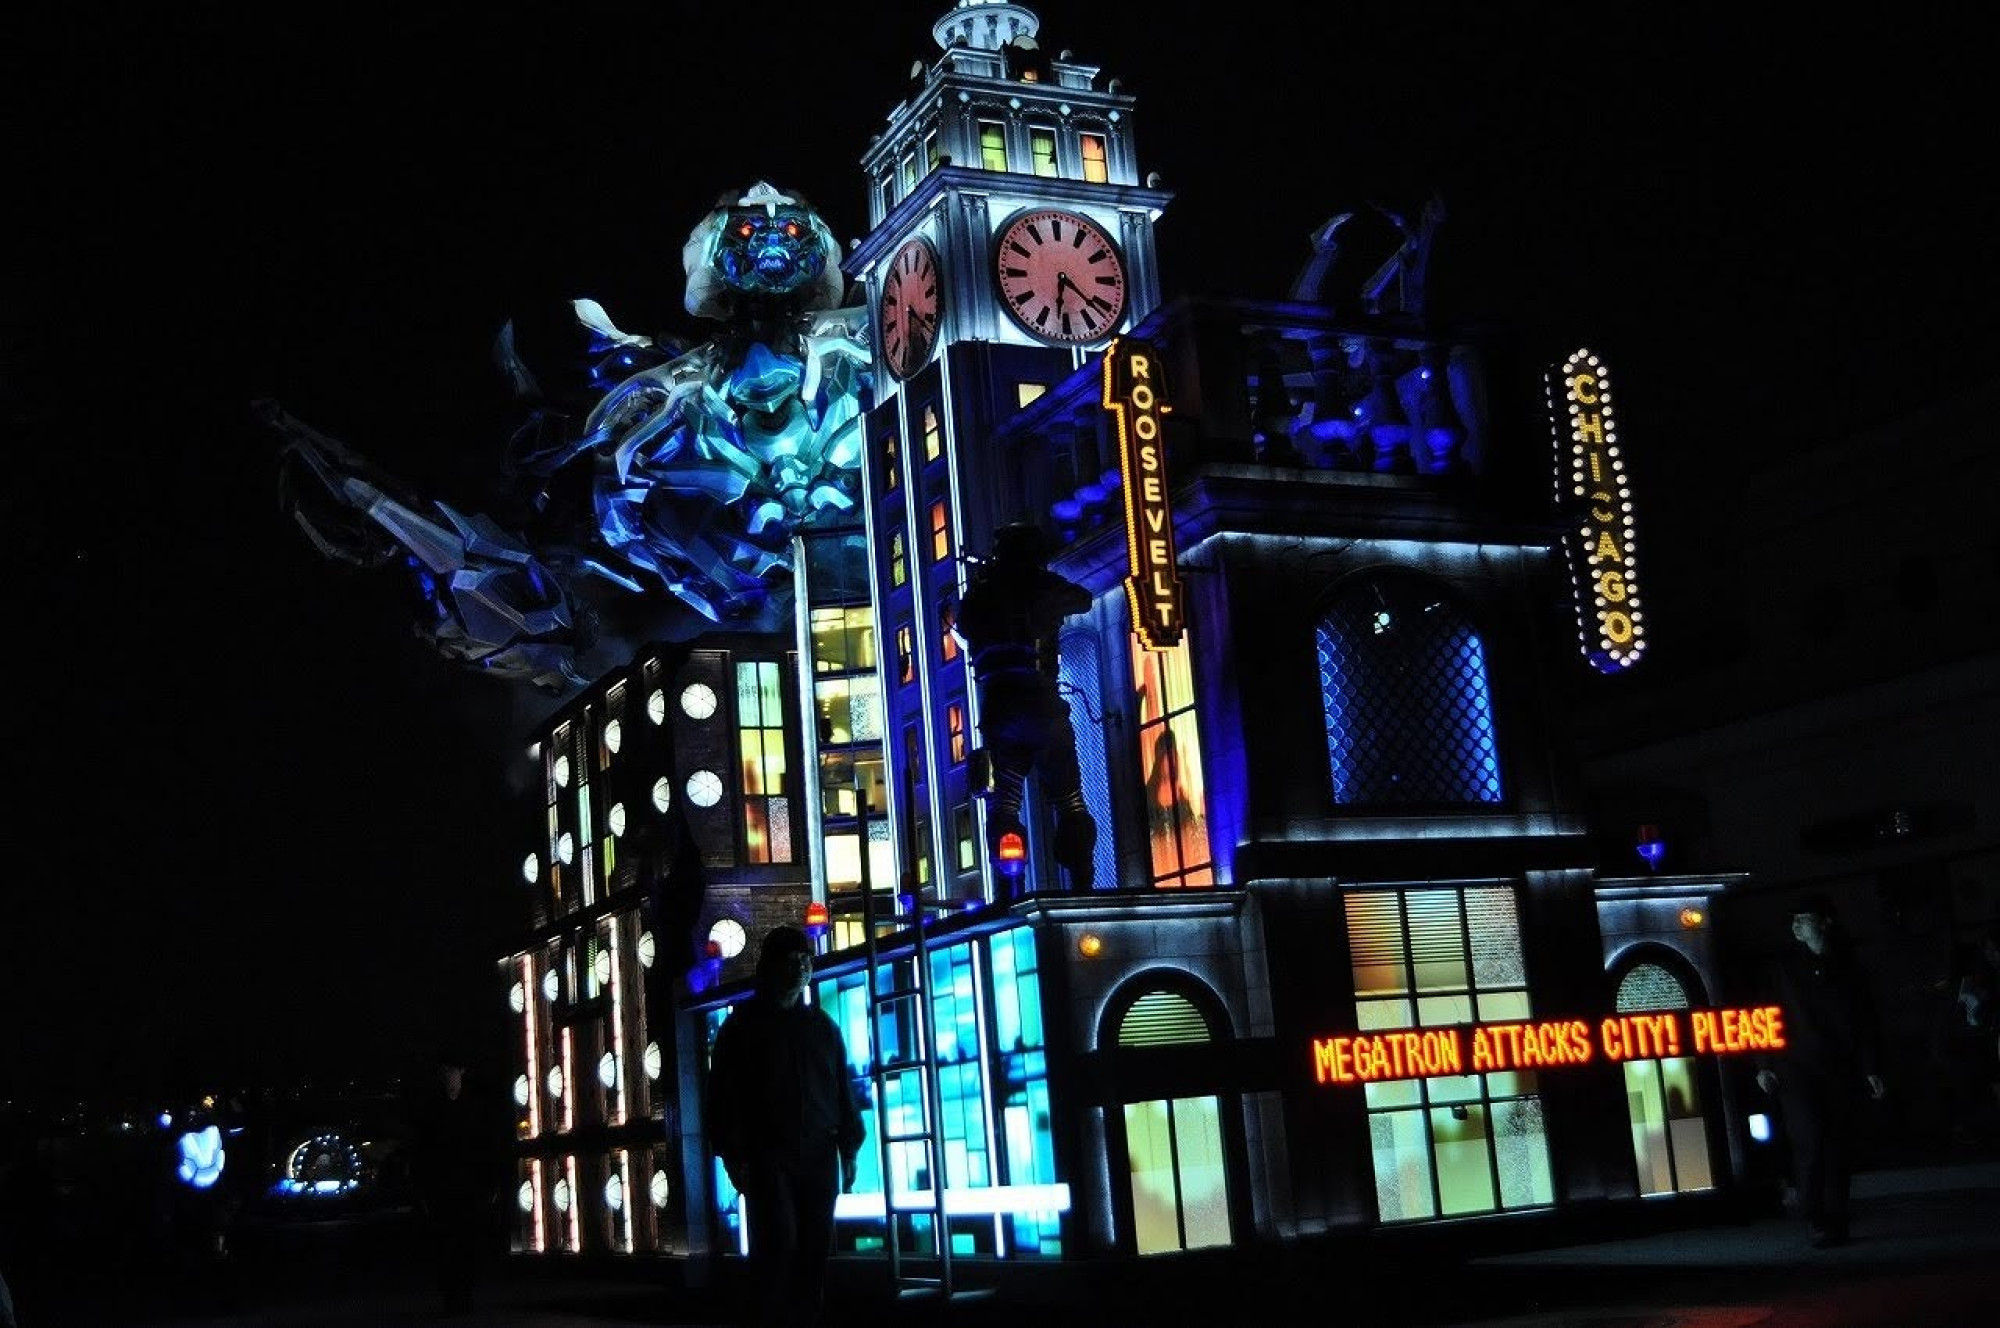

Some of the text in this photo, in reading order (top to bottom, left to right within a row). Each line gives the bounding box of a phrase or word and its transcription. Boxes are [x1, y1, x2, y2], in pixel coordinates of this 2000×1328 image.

[1130, 355, 1173, 627] ROOSEVELT
[1573, 374, 1633, 643] CHICAGO
[1313, 1006, 1785, 1083] MEGATRON ATTACKS CITY! PLEASE
